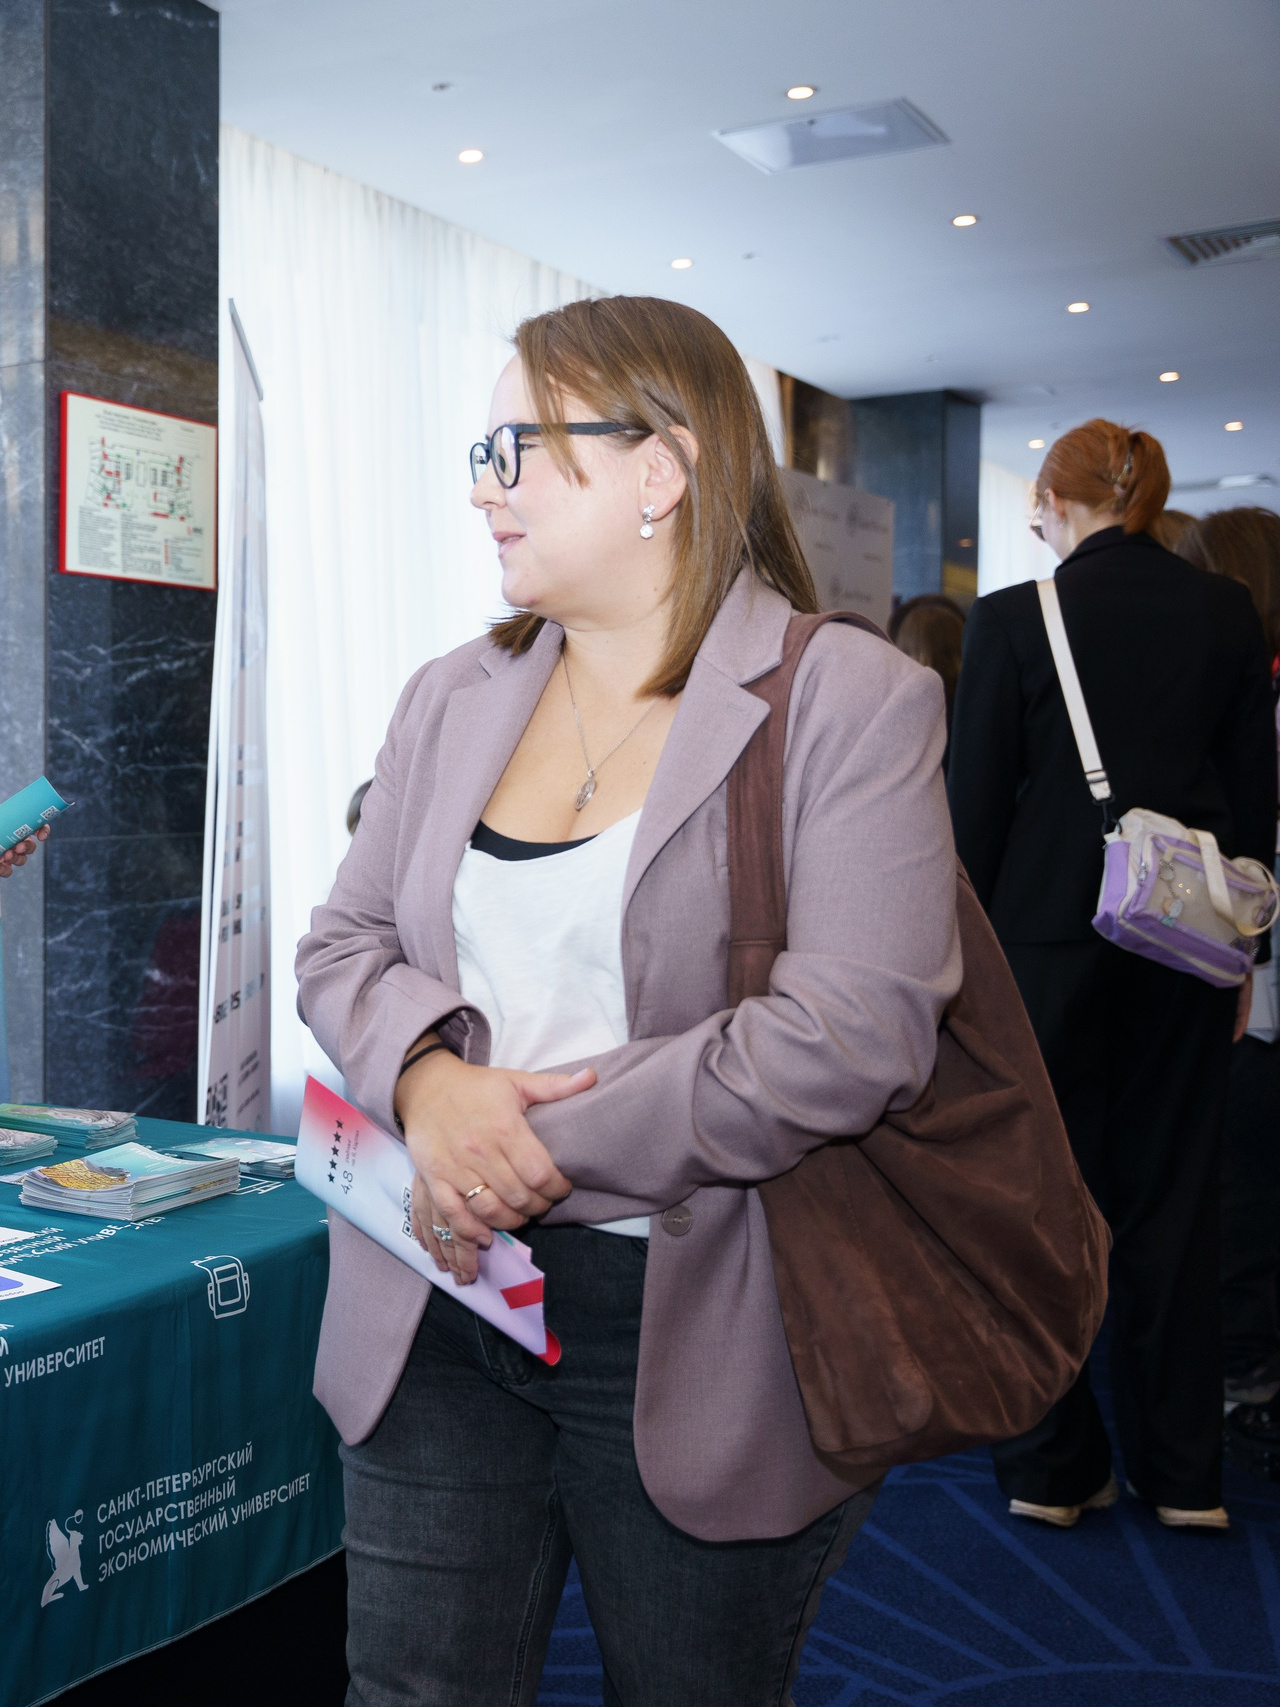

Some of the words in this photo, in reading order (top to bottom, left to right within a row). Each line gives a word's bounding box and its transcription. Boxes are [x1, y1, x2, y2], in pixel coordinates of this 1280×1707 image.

[341, 1170, 353, 1195] 4,8
[4, 1336, 106, 1388] УНИВЕРСИТЕТ
[97, 1441, 253, 1524] САНКТ-ПЕТЕРБУРГСКИЙ
[99, 1476, 237, 1554] ГОСУДАРСТВЕННЫЙ
[98, 1508, 229, 1583] ЭКОНОМИЧЕСКИЙ
[231, 1472, 311, 1526] УНИВЕРСИТЕТ
